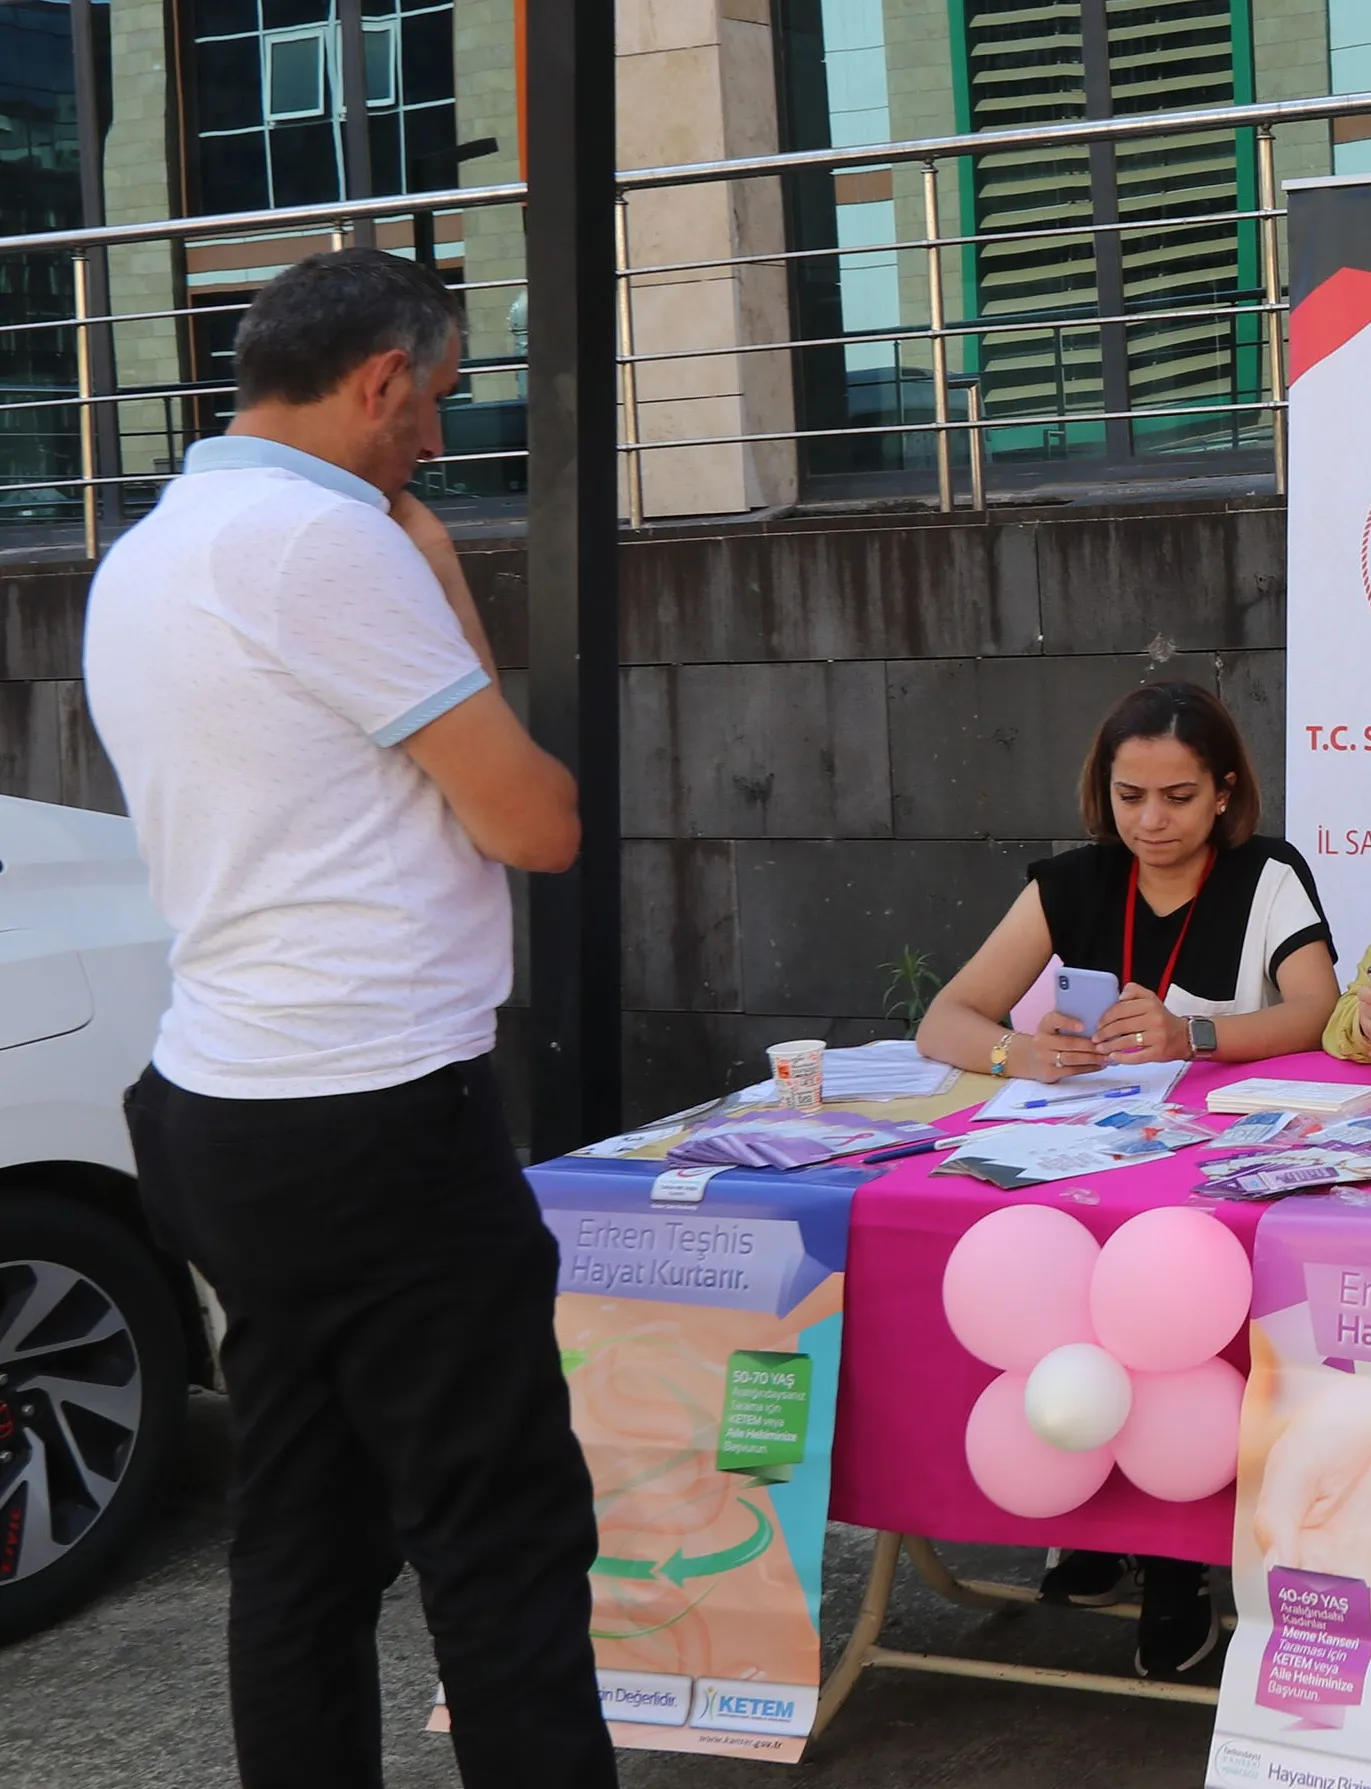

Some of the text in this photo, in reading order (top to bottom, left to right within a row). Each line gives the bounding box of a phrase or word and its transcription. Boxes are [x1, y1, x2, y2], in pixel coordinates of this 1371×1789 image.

[1306, 726, 1356, 751] T.C.
[1317, 824, 1339, 855] İL
[577, 1218, 755, 1260] Erken Teşhis
[571, 1255, 749, 1290] Hayat Kurtarır.
[733, 1370, 795, 1389] 50-70 YAŞ
[1279, 1587, 1348, 1614] 40-69 YAŞ
[1279, 1638, 1347, 1662] Taraması için
[1282, 1625, 1360, 1650] Meme Kanseri
[1273, 1651, 1339, 1676] KETEM veya
[1269, 1666, 1354, 1692] Aile Hekiminize
[719, 1696, 794, 1718] KETEM
